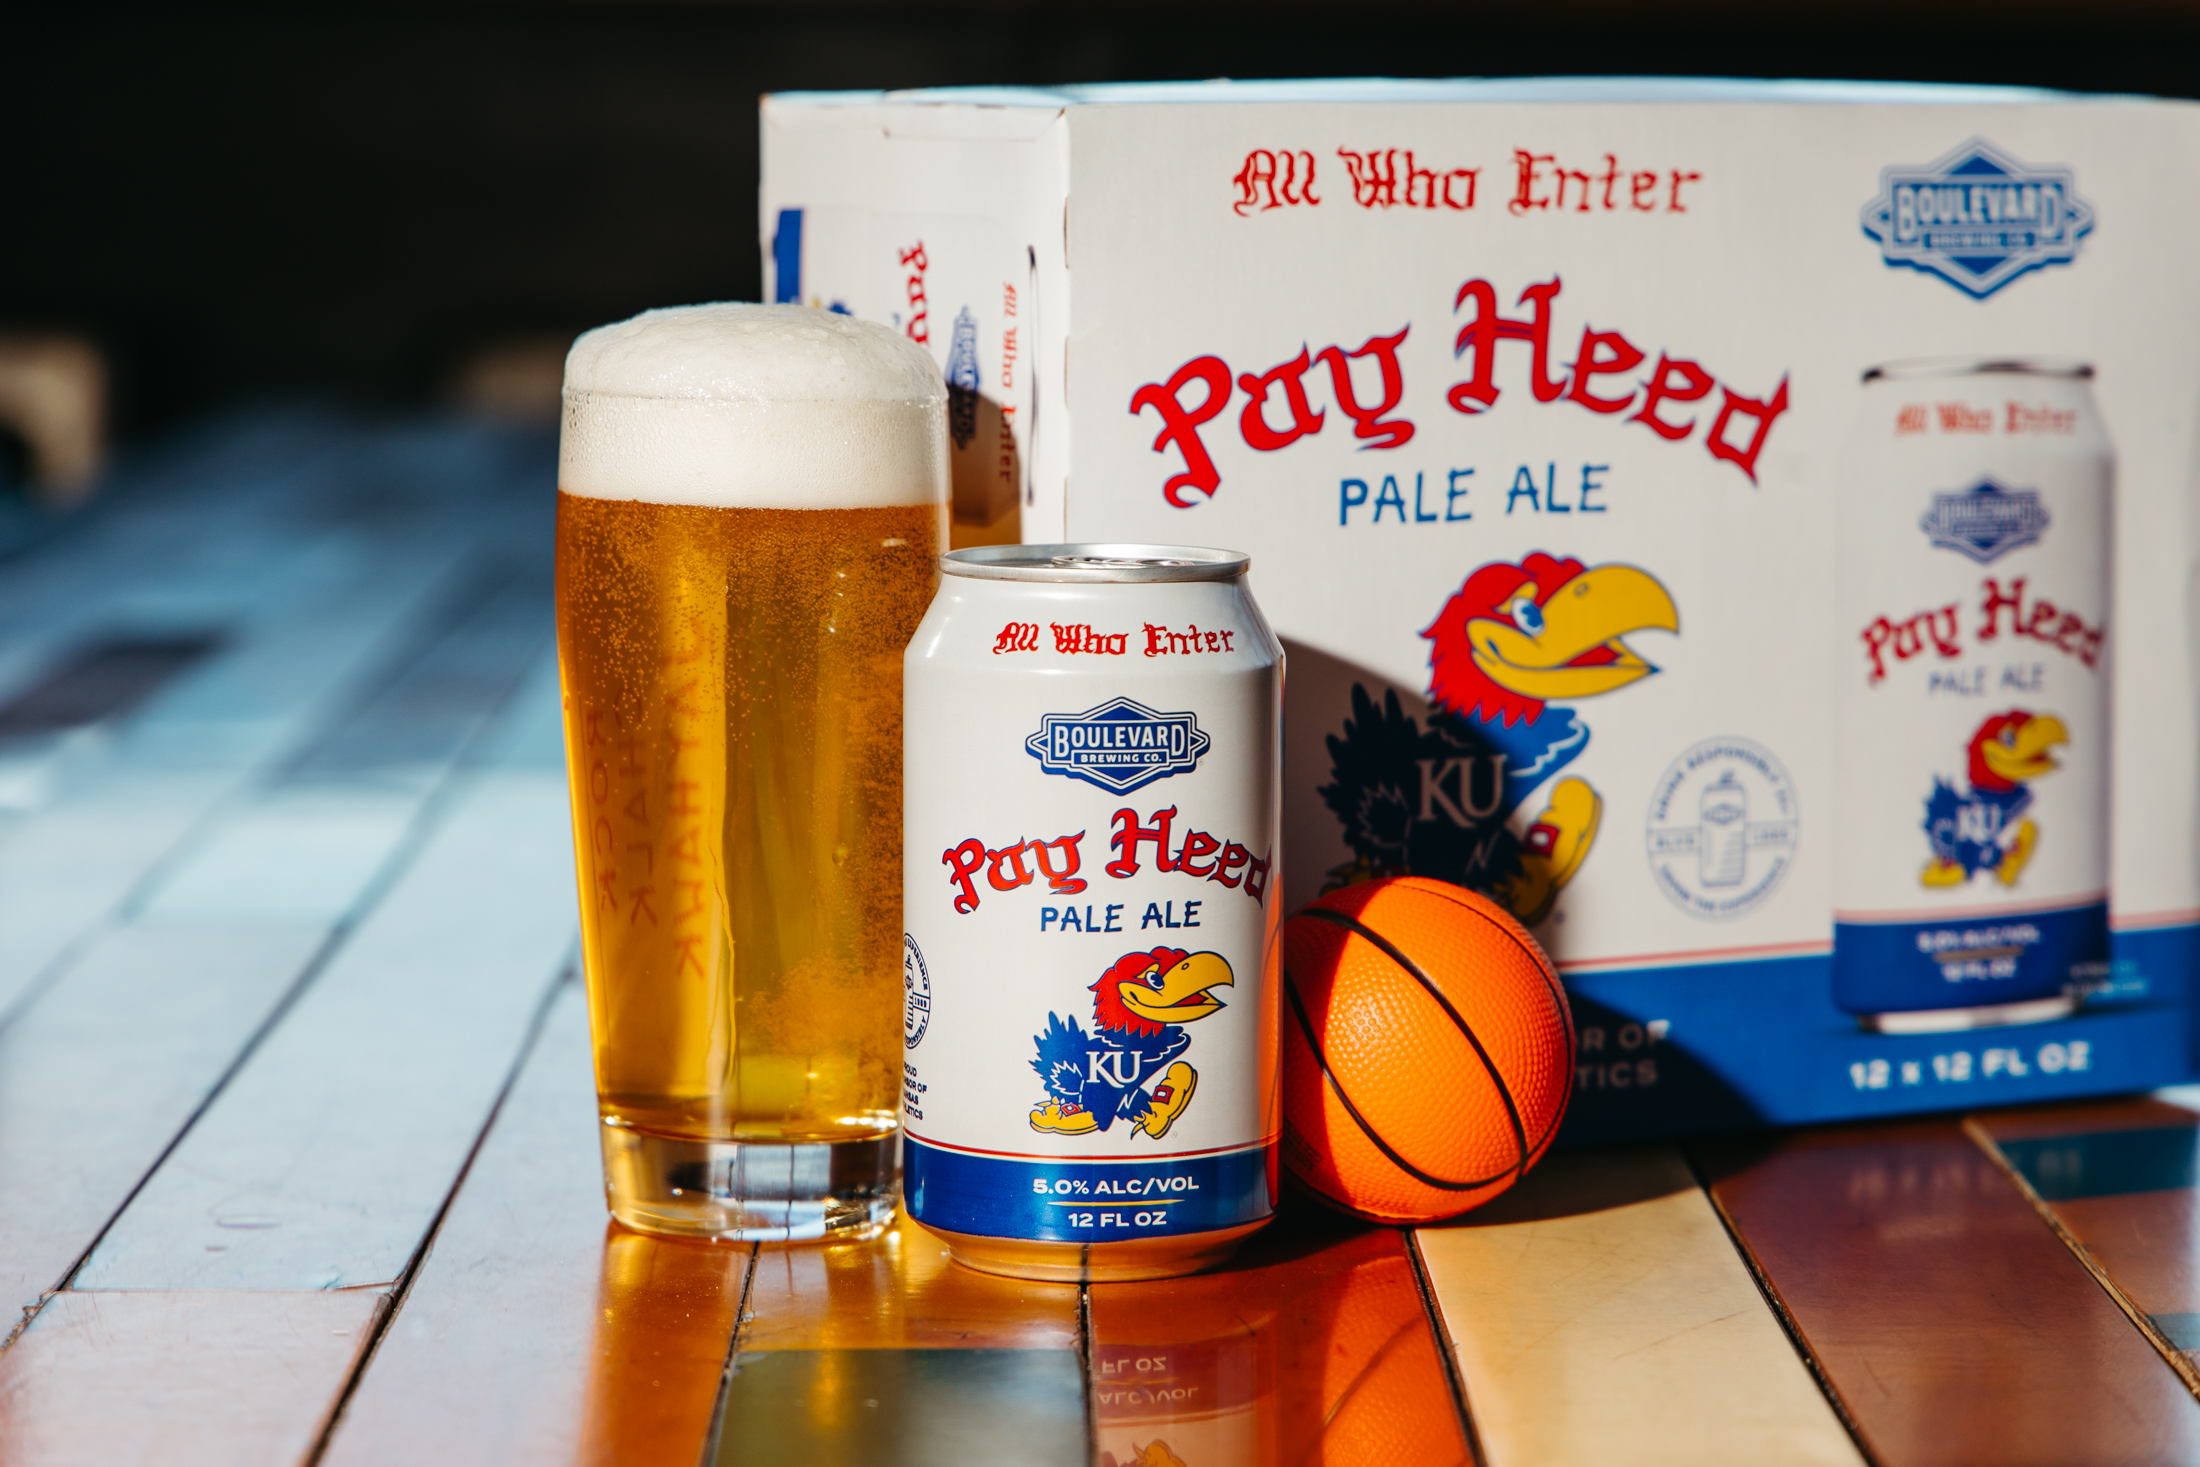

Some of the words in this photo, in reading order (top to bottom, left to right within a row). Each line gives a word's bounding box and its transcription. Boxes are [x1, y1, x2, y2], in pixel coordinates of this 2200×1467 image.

[1233, 149, 1321, 216] All
[1337, 146, 1481, 210] Who
[1508, 146, 1702, 217] Enter
[1897, 185, 2059, 240] BOULEVARD
[1003, 326, 1018, 389] Who
[1129, 322, 1415, 509] Pay
[1446, 273, 1789, 488] Heed
[1340, 468, 1475, 526] PALE
[1506, 462, 1610, 514] ALE
[992, 622, 1039, 655] All
[1050, 622, 1129, 656] Who
[1142, 622, 1235, 657] Enter
[1861, 599, 1962, 690] Pay
[1928, 665, 1986, 695] PALE
[2001, 663, 2043, 691] ALE
[1055, 725, 1186, 757] BOULEVARD
[1080, 753, 1140, 763] BREWING
[1143, 753, 1162, 763] CO.
[1415, 754, 1509, 828] KU
[1957, 804, 2002, 843] KU
[942, 829, 1088, 914] Pay
[1105, 805, 1272, 909] Heed
[1041, 904, 1124, 933] PALE
[1141, 900, 1203, 929] ALE
[1086, 1051, 1143, 1088] KU
[1849, 1058, 1890, 1090] 12
[1932, 1050, 1973, 1082] 12
[1981, 1048, 2028, 1078] FL
[2036, 1040, 2091, 1074] OZ
[917, 1083, 927, 1094] OF
[1033, 1179, 1089, 1195] 5.0%
[1094, 1176, 1199, 1195] ALC/VOL
[1068, 1213, 1094, 1228] 12
[1100, 1212, 1130, 1228] FL
[1134, 1211, 1167, 1227] OZ
